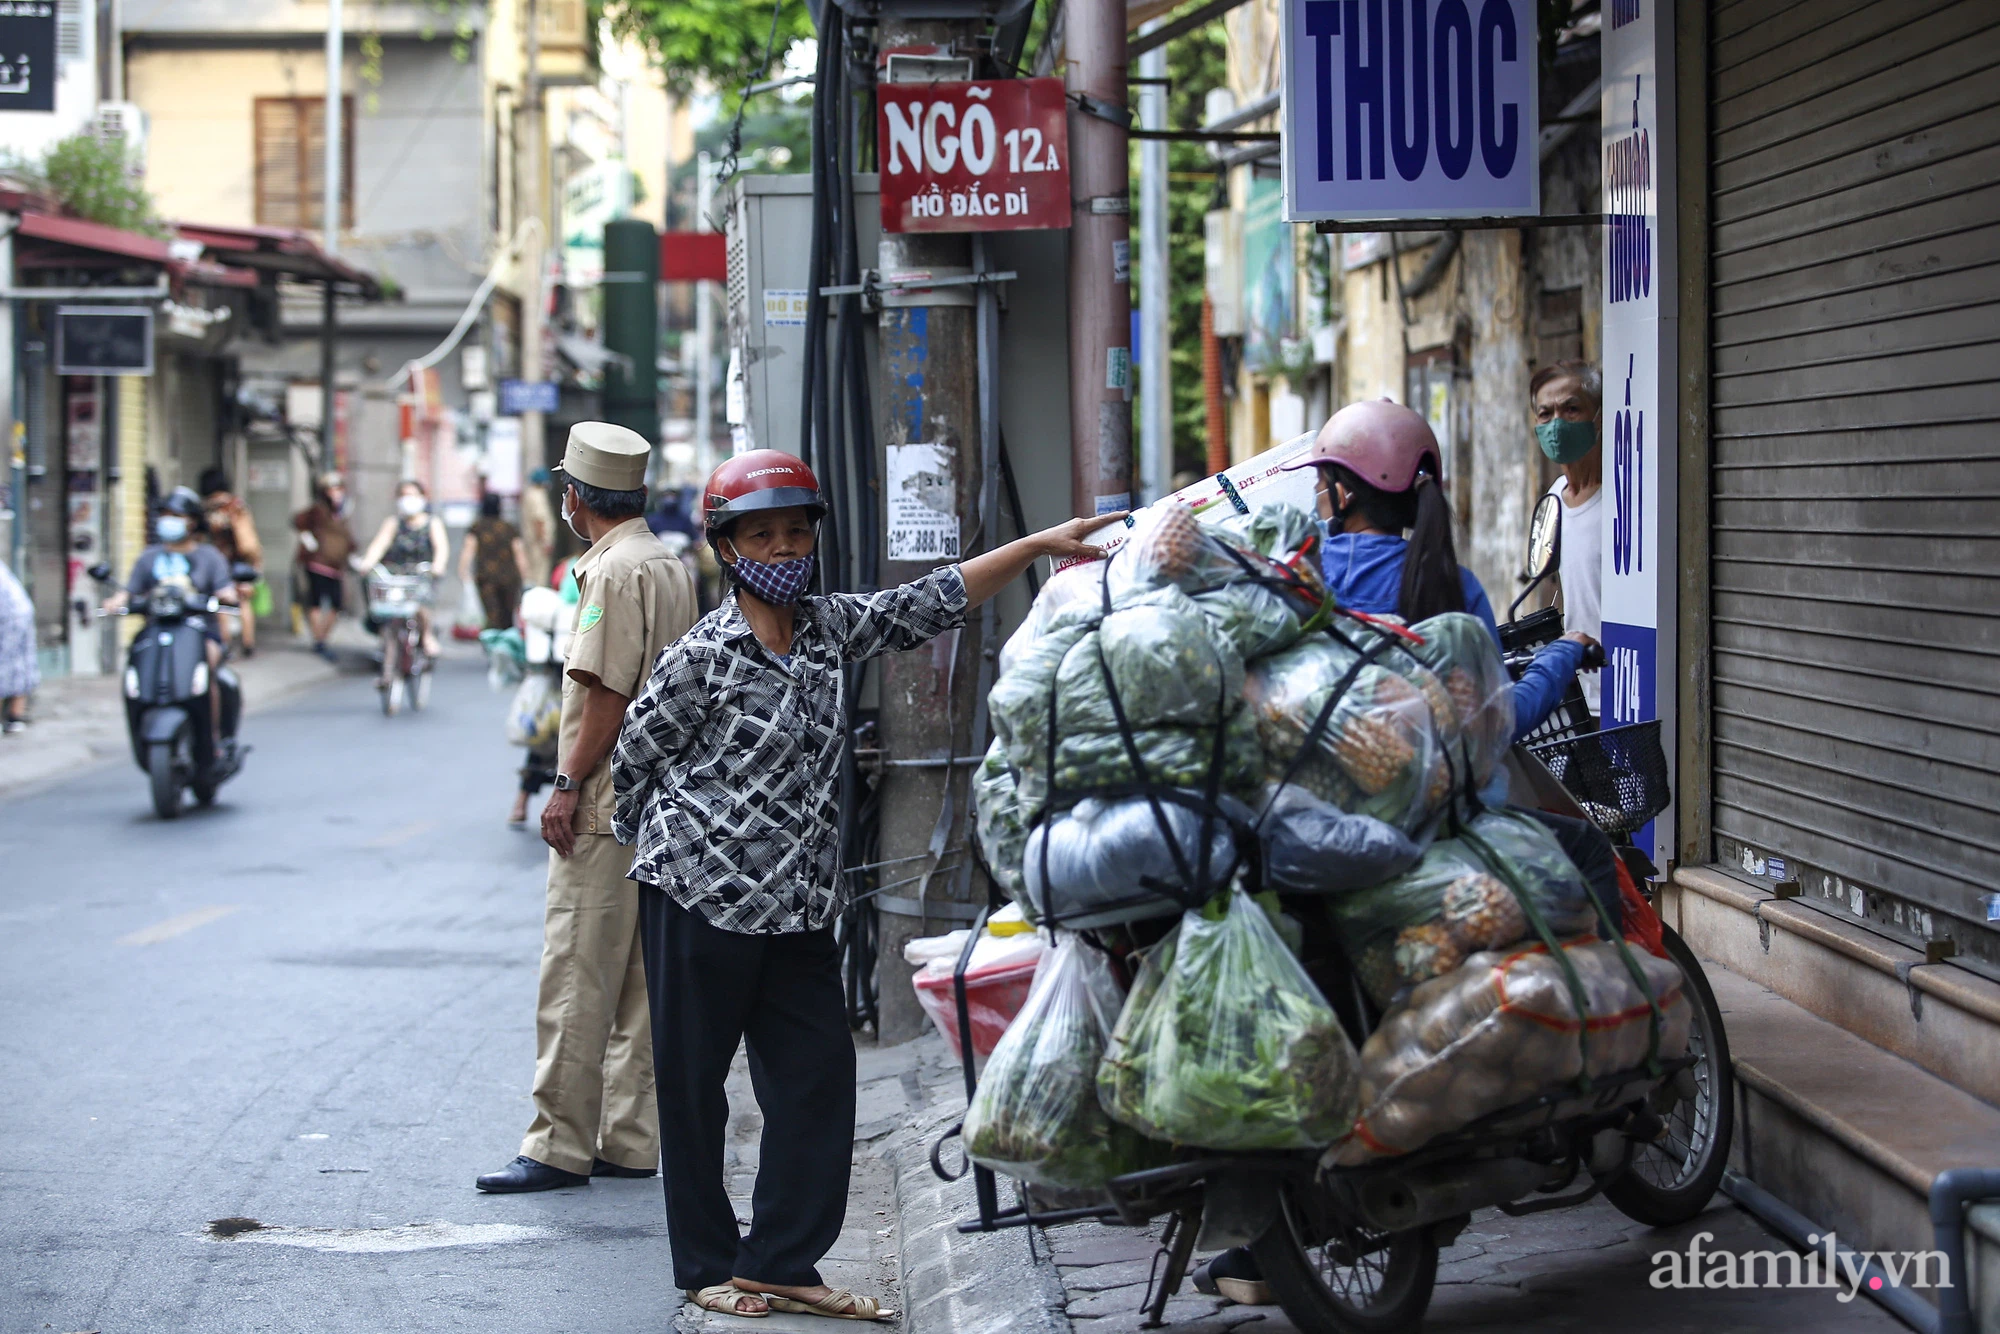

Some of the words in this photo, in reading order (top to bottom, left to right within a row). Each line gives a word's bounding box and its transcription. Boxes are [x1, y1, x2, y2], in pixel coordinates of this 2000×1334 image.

[884, 86, 996, 176] NGÕ
[1003, 128, 1060, 173] 12A
[911, 182, 945, 217] HỒ
[950, 180, 1000, 217] ĐẮC
[746, 467, 795, 479] HONDA
[1613, 353, 1633, 577] SỐ
[1636, 410, 1643, 573] 1
[1612, 646, 1641, 723] 1/14
